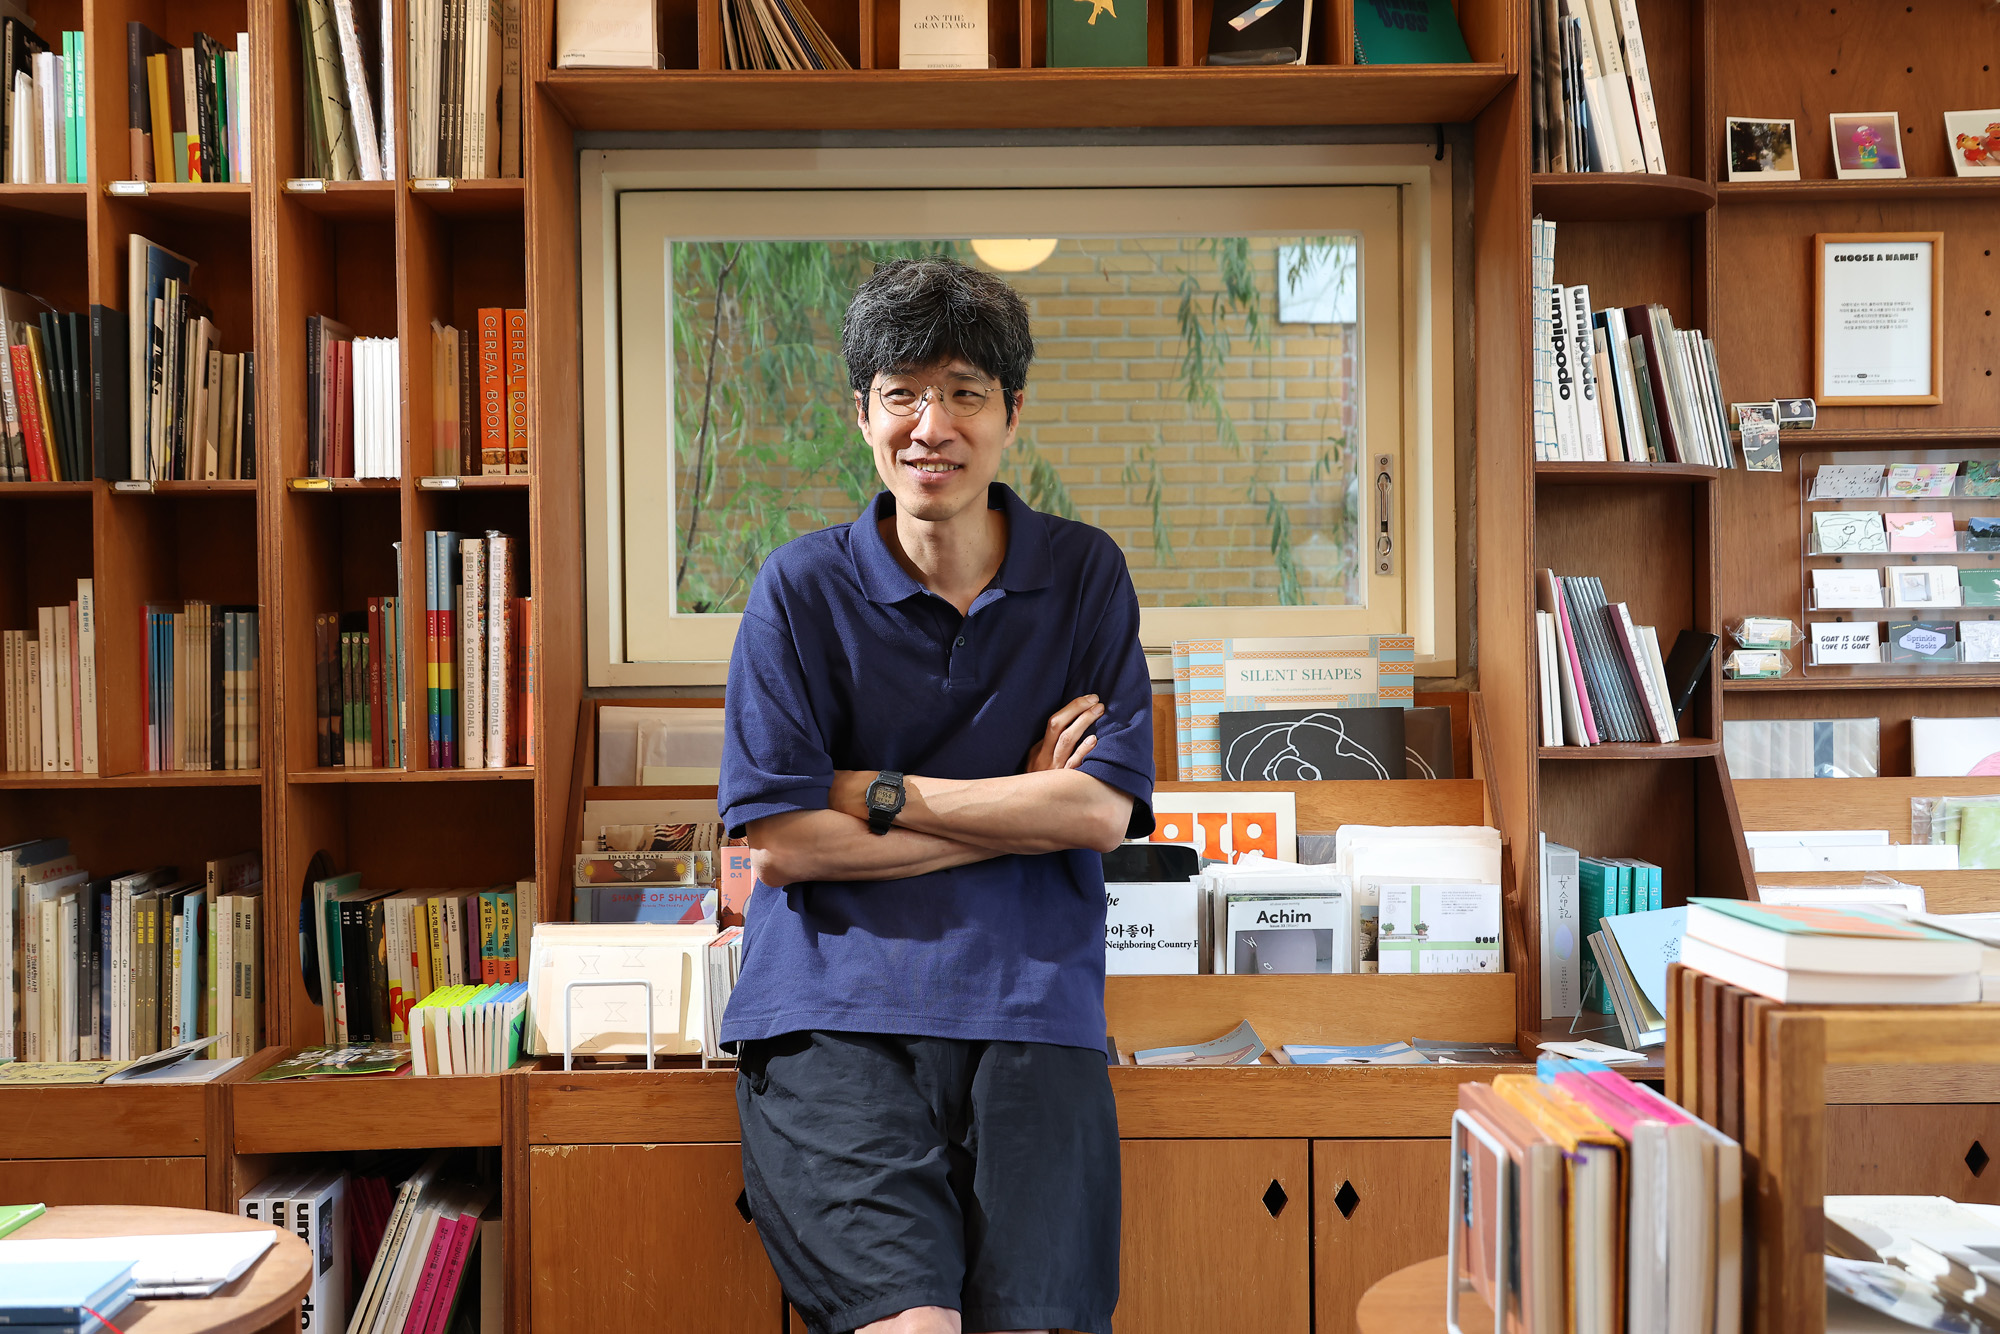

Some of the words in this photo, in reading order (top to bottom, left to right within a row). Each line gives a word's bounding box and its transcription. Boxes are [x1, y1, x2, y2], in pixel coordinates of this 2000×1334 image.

[1834, 254, 1874, 262] CHOOSE
[1885, 253, 1919, 262] NAME!
[484, 315, 498, 384] CEREAL
[511, 315, 526, 384] CEREAL
[1551, 287, 1573, 401] umipodo
[1573, 287, 1597, 401] umipodo
[3, 389, 17, 422] Dying
[486, 391, 500, 440] BOOK
[513, 391, 527, 440] BOOK
[466, 605, 474, 629] TOYS
[492, 603, 500, 628] TOYS
[1906, 635, 1937, 643] Sprinkle
[492, 645, 500, 677] OTHER
[1240, 669, 1298, 682] SILENT
[1302, 668, 1362, 681] SHAPES
[467, 681, 475, 737] MEMORIALS
[491, 679, 499, 736] MEMORIALS
[484, 900, 492, 915] 흠결
[501, 901, 509, 915] 흠결
[611, 893, 647, 902] SHAPE
[650, 893, 663, 902] OF
[668, 893, 705, 902] SHAME
[485, 916, 493, 930] 없는
[502, 917, 509, 931] 없는
[1256, 909, 1312, 924] Achim
[485, 932, 493, 959] 파편들의
[502, 933, 510, 960] 파편들의
[1105, 940, 1156, 951] Neighboring
[1157, 939, 1192, 950] Country
[487, 961, 494, 975] 사회
[504, 962, 511, 976] 사회
[430, 1243, 444, 1269] 고양이를
[450, 1241, 465, 1266] 고양이를
[423, 1272, 434, 1292] 찾아서
[444, 1269, 455, 1289] 찾아서
